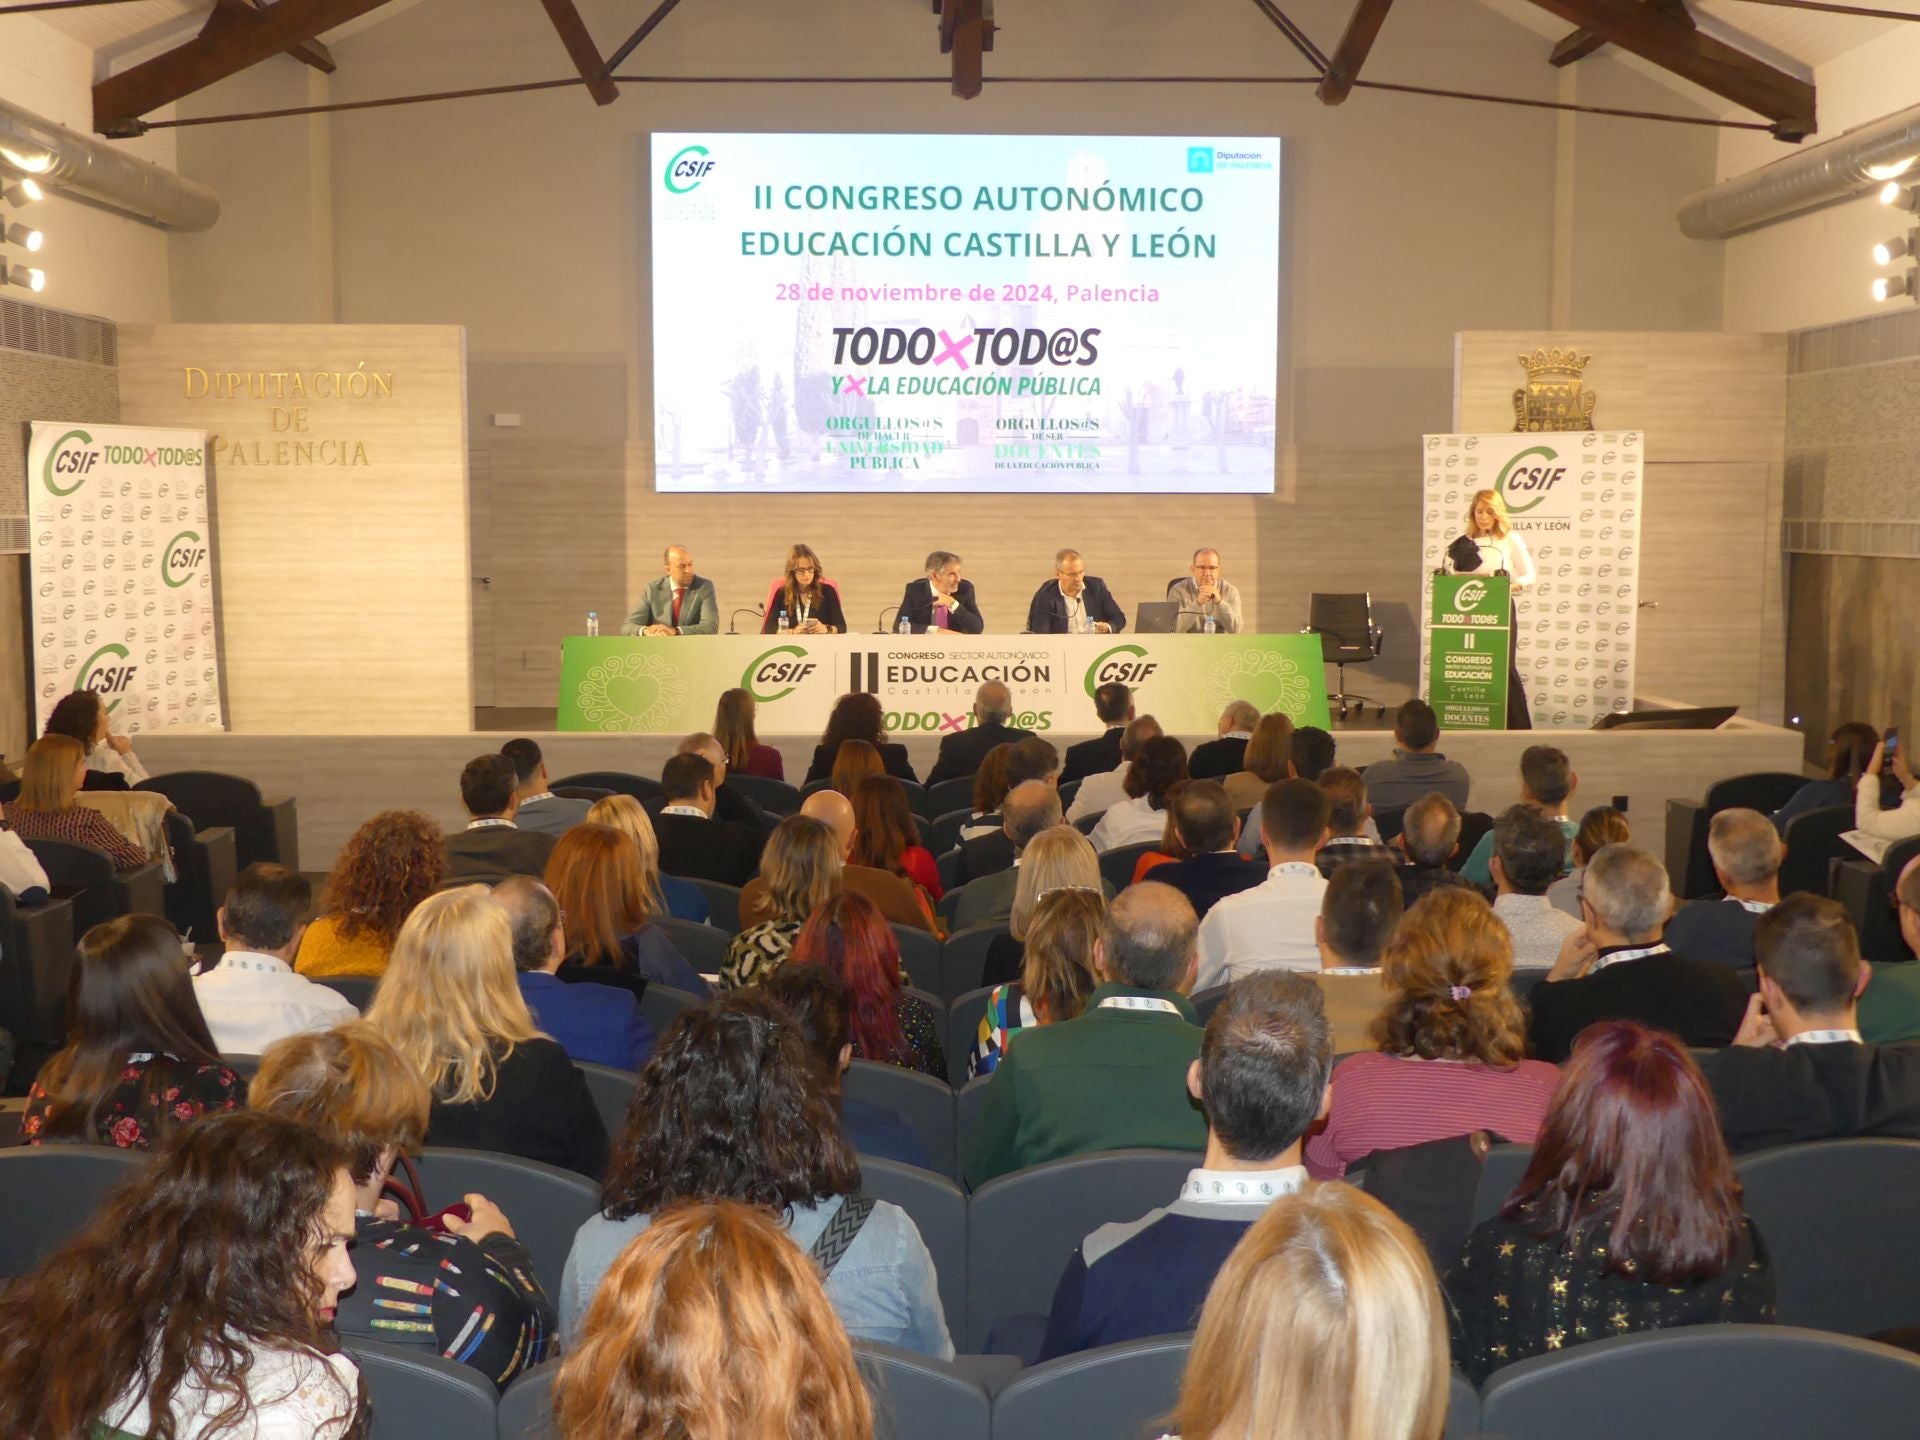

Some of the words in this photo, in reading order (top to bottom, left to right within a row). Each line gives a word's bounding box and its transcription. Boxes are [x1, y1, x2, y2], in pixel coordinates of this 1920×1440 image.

[674, 160, 716, 178] CSIF
[754, 185, 772, 210] II
[784, 185, 963, 211] CONGRESO
[972, 179, 1205, 213] AUTONÓMICO
[741, 224, 932, 257] EDUCACIÓN
[943, 231, 1092, 258] CASTILLA
[1101, 233, 1121, 258] Y
[1132, 226, 1216, 259] LEÓN
[775, 283, 801, 302] 28
[807, 282, 834, 302] de
[841, 282, 962, 303] noviembre
[968, 283, 996, 303] de
[1002, 284, 1059, 305] 2024,
[1066, 284, 1160, 304] Palencia
[896, 371, 1011, 397] EDUCACIÓN
[1016, 371, 1101, 397] PÚBLICA
[271, 406, 309, 433] DE
[55, 450, 99, 474] CSIF
[1508, 467, 1566, 490] CSIF
[1535, 521, 1542, 531] Y
[1544, 519, 1571, 531] LEÓN
[170, 548, 206, 568] CSIF
[887, 652, 945, 660] CONGRESO
[949, 652, 984, 660] SECTOR
[986, 650, 1049, 660] AUTONÓMICO
[1445, 656, 1493, 664] CONGRESO
[86, 665, 138, 694] CSIF
[756, 662, 817, 683] CSIF
[887, 660, 1050, 683] EDUCACIÓN
[1099, 662, 1158, 682] CSIF
[1444, 670, 1492, 679] EDUCACIÓN
